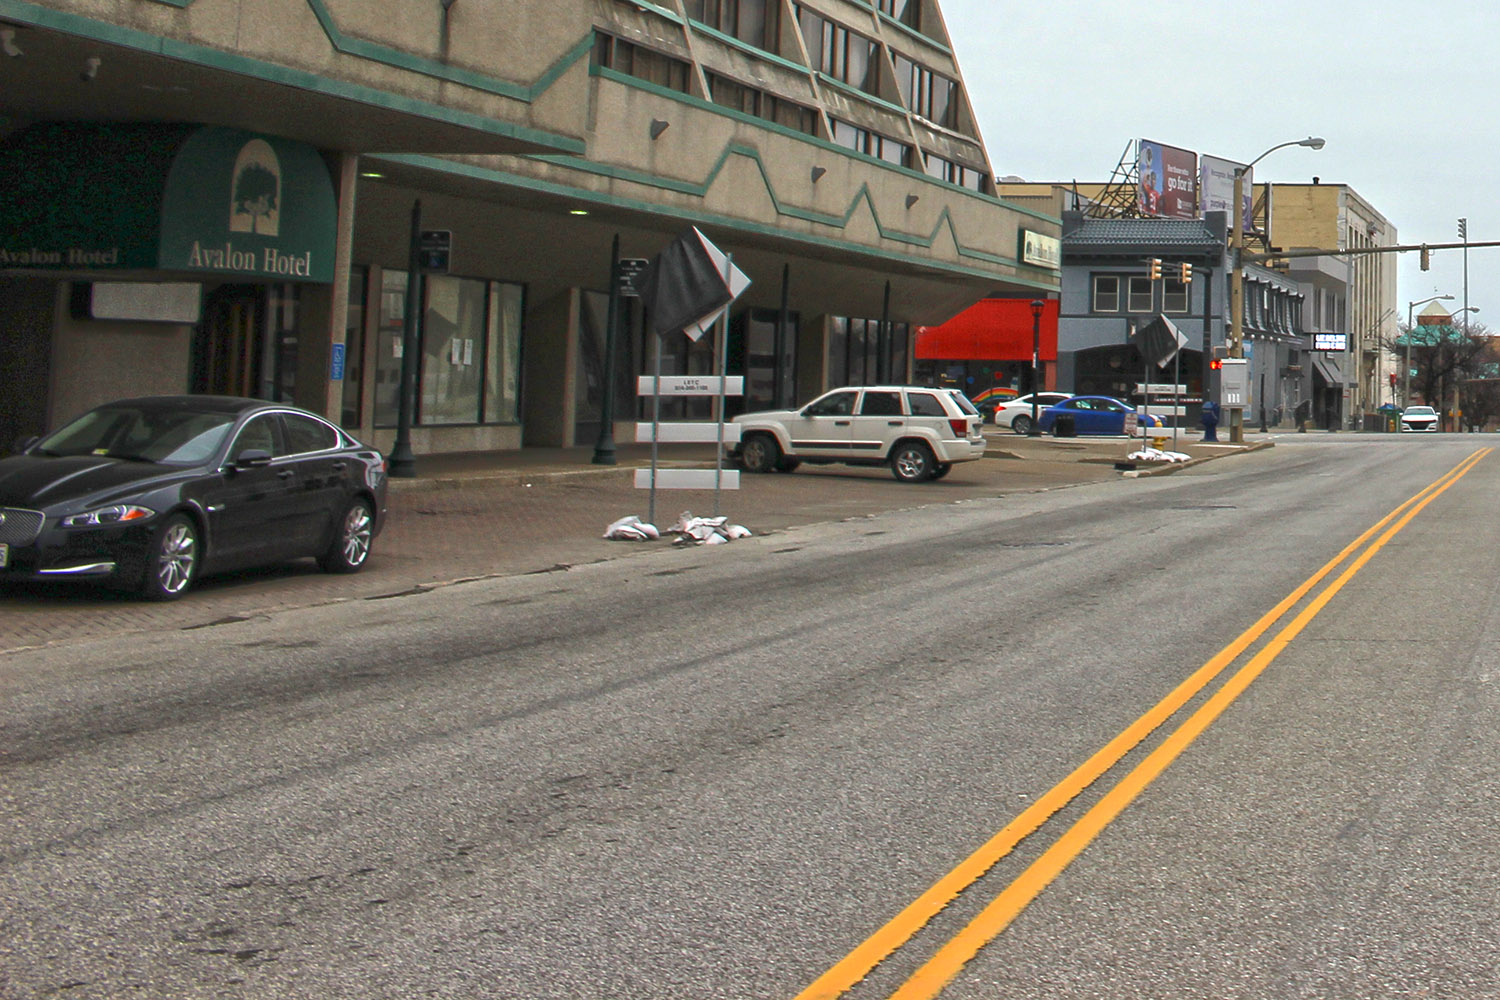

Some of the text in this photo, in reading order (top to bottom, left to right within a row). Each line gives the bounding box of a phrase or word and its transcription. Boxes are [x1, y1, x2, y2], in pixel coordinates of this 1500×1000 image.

[1168, 177, 1177, 191] go
[1177, 176, 1187, 191] for
[0, 248, 119, 265] Avalon Hotel
[188, 240, 313, 278] Avalon Hotel
